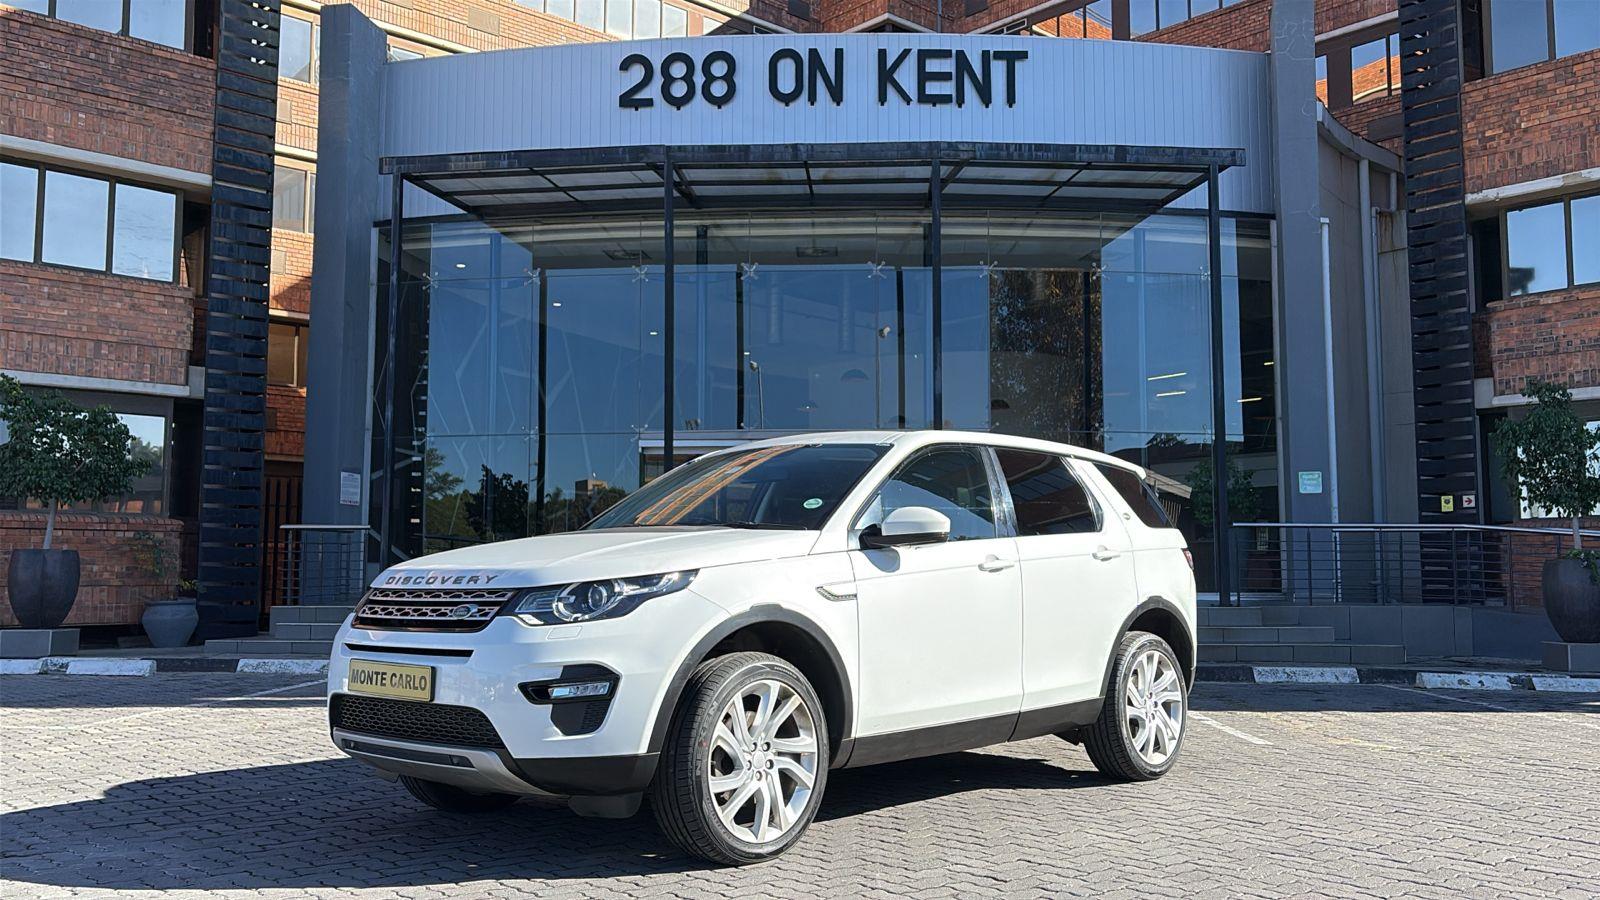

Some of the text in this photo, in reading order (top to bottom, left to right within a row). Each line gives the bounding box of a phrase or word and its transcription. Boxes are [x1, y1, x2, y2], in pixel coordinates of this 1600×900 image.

[618, 48, 1029, 107] 288 ON KENT
[385, 575, 500, 586] DISCOVERY
[350, 668, 428, 692] MONTE CARLO
